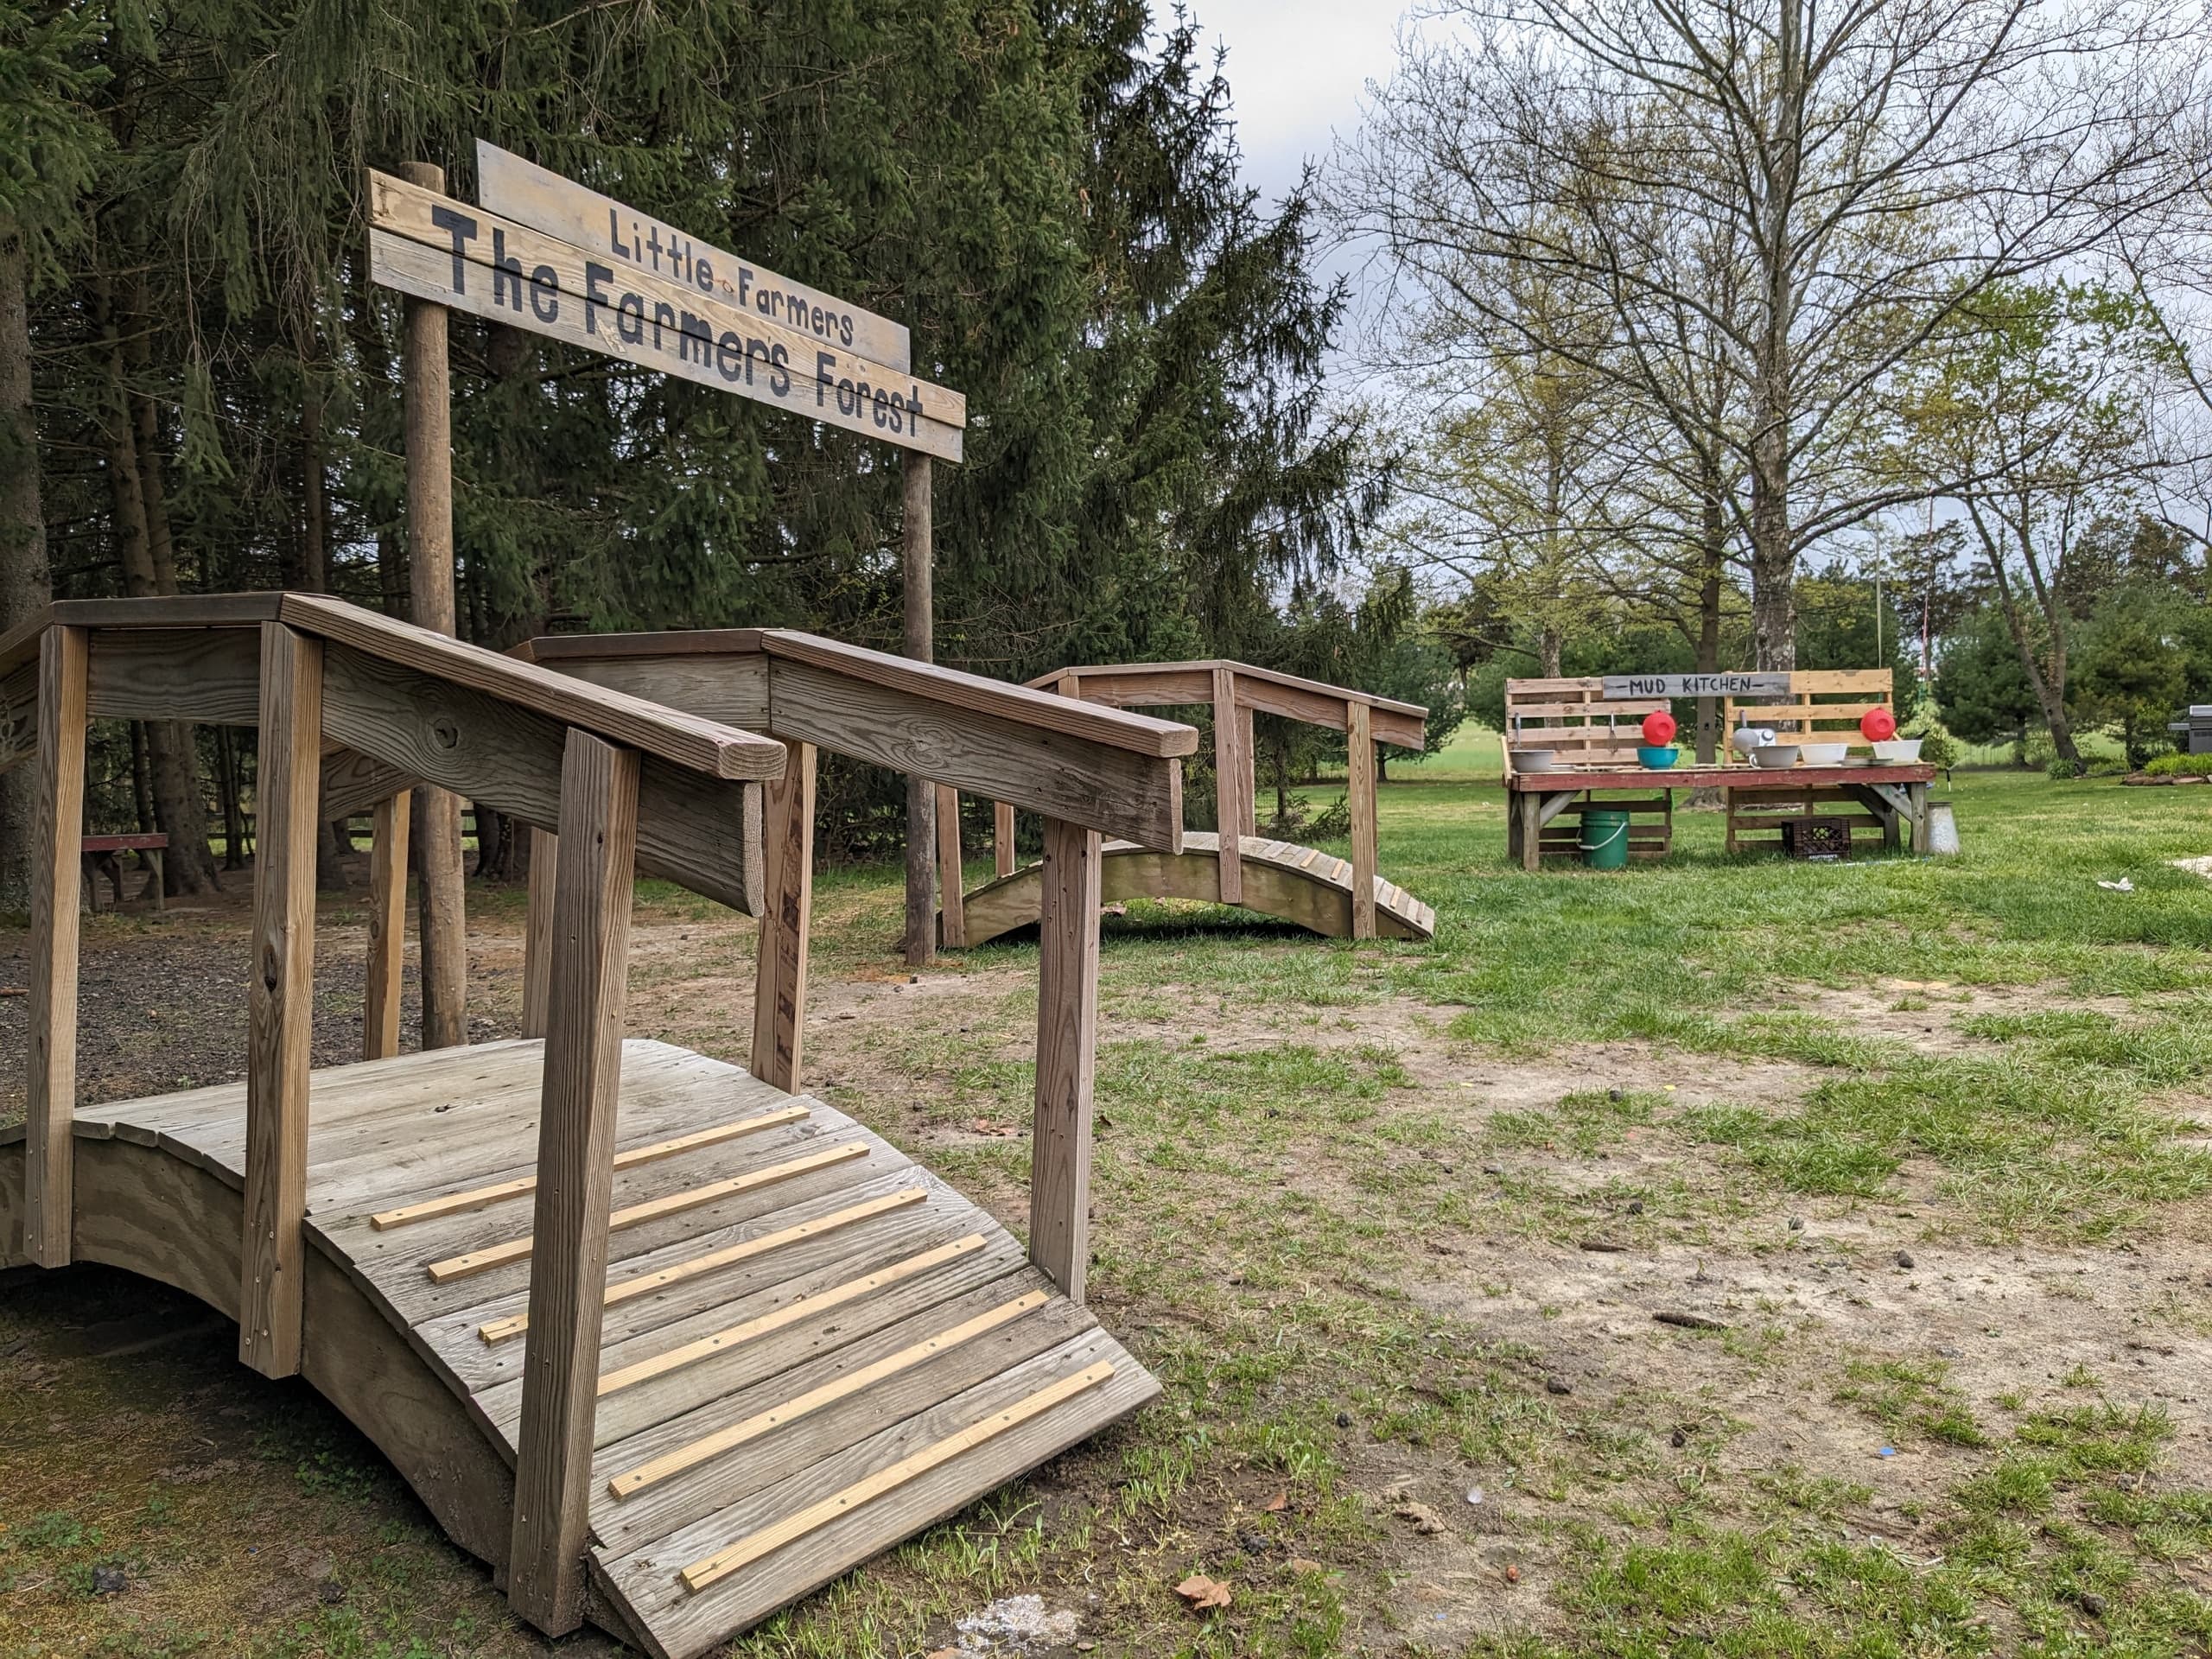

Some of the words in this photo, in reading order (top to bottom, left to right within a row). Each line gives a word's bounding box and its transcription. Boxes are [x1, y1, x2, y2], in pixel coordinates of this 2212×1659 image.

[432, 204, 559, 323] The
[817, 351, 923, 436] Forest
[610, 208, 713, 292] Little
[739, 266, 854, 346] Farmers
